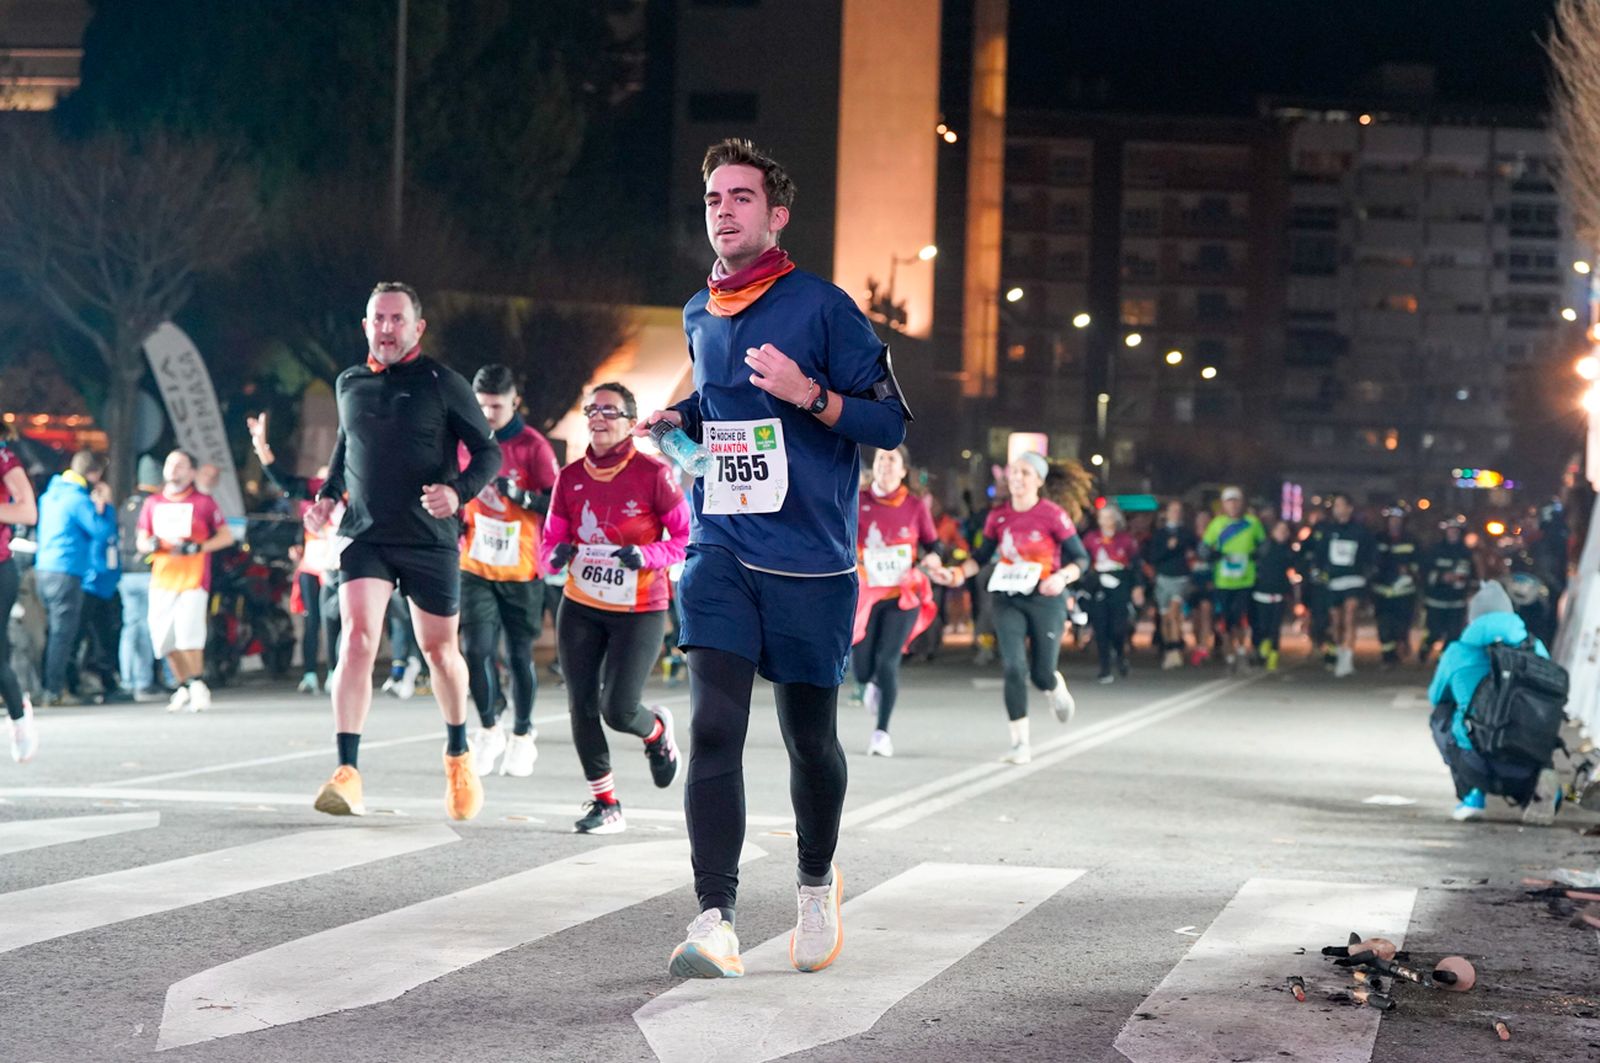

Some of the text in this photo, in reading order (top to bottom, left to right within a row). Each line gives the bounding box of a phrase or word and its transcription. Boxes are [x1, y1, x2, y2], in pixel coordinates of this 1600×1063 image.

[178, 351, 228, 470] APEMASA
[717, 431, 736, 441] NOCHE
[737, 431, 746, 441] DE
[711, 443, 723, 453] SAN
[723, 442, 748, 453] ANTÓN
[716, 454, 769, 482] 7555
[581, 565, 624, 586] 6648
